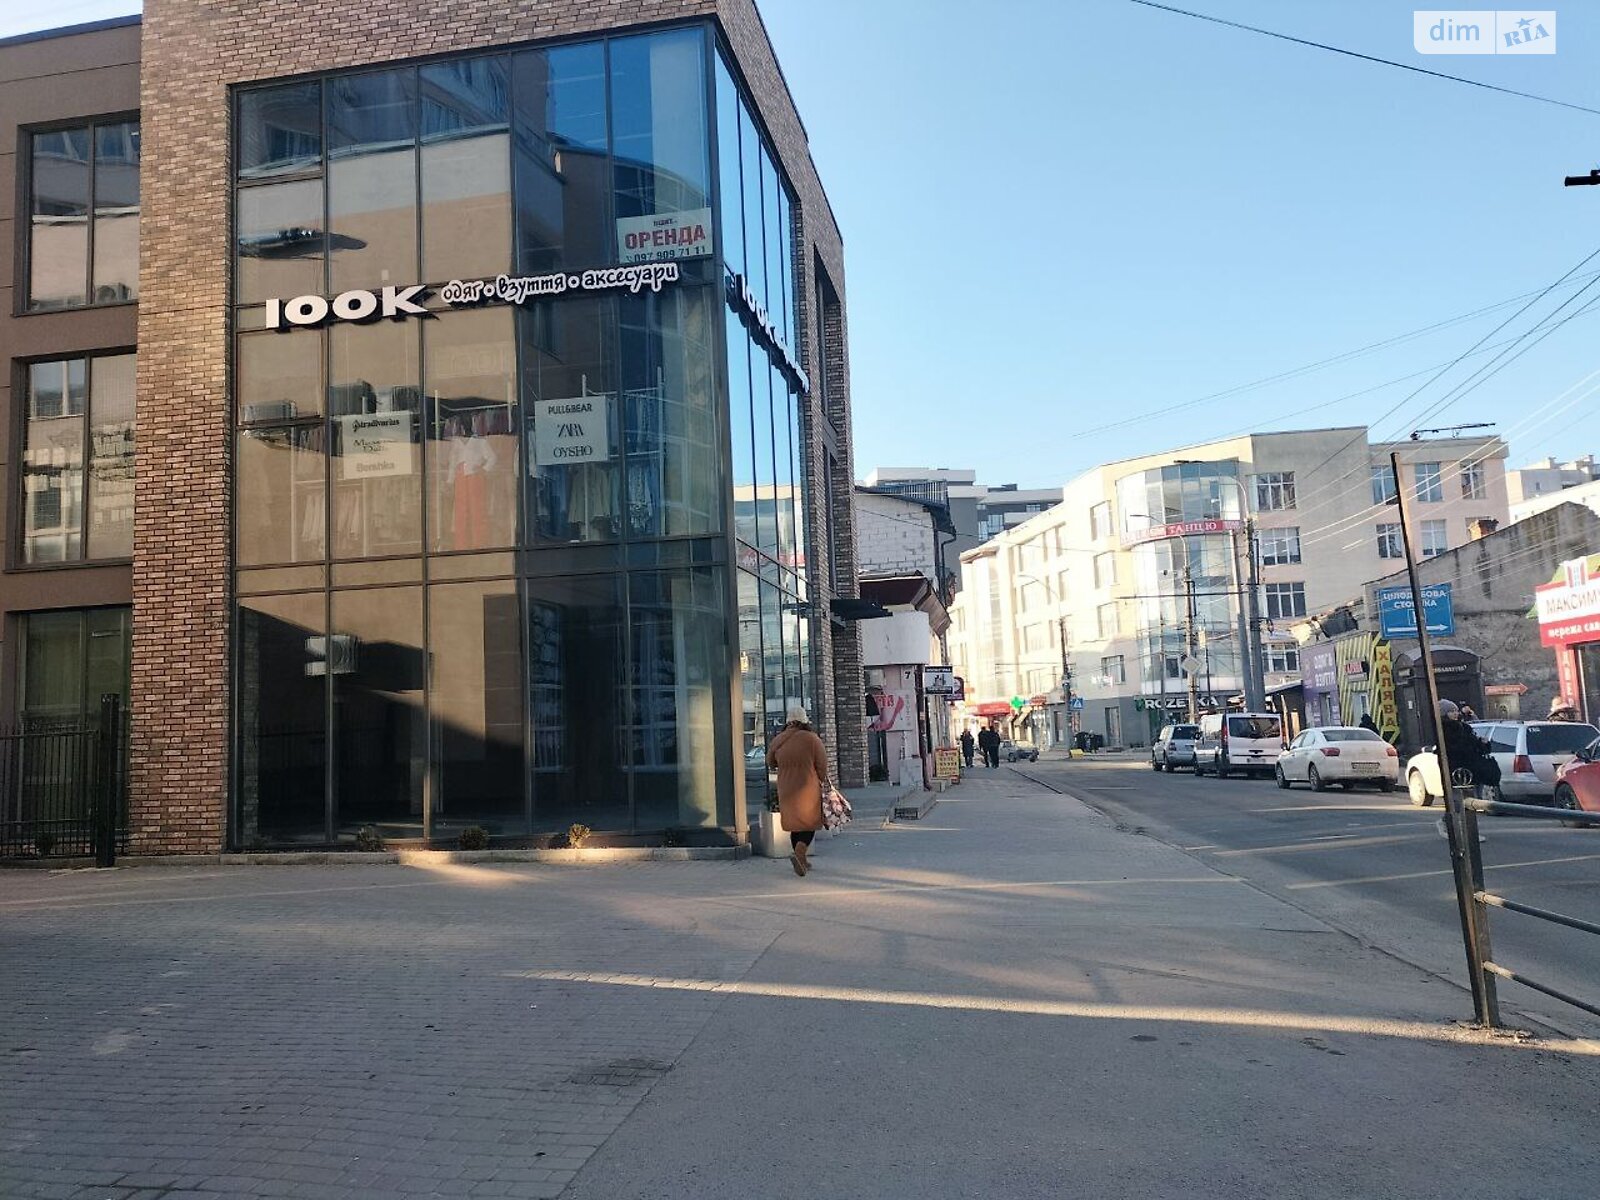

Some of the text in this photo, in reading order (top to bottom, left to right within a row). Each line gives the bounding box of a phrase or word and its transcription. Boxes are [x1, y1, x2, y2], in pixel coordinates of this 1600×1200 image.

[625, 225, 706, 249] ОРЕНДА
[443, 264, 677, 303] одяг взуття аксесуари
[548, 403, 593, 415] PULL&BEAR
[553, 445, 593, 458] OYSHO
[1383, 589, 1447, 601] ЦІЛОДБОВА
[904, 670, 911, 679] 7
[1145, 697, 1219, 709] ROZEKA
